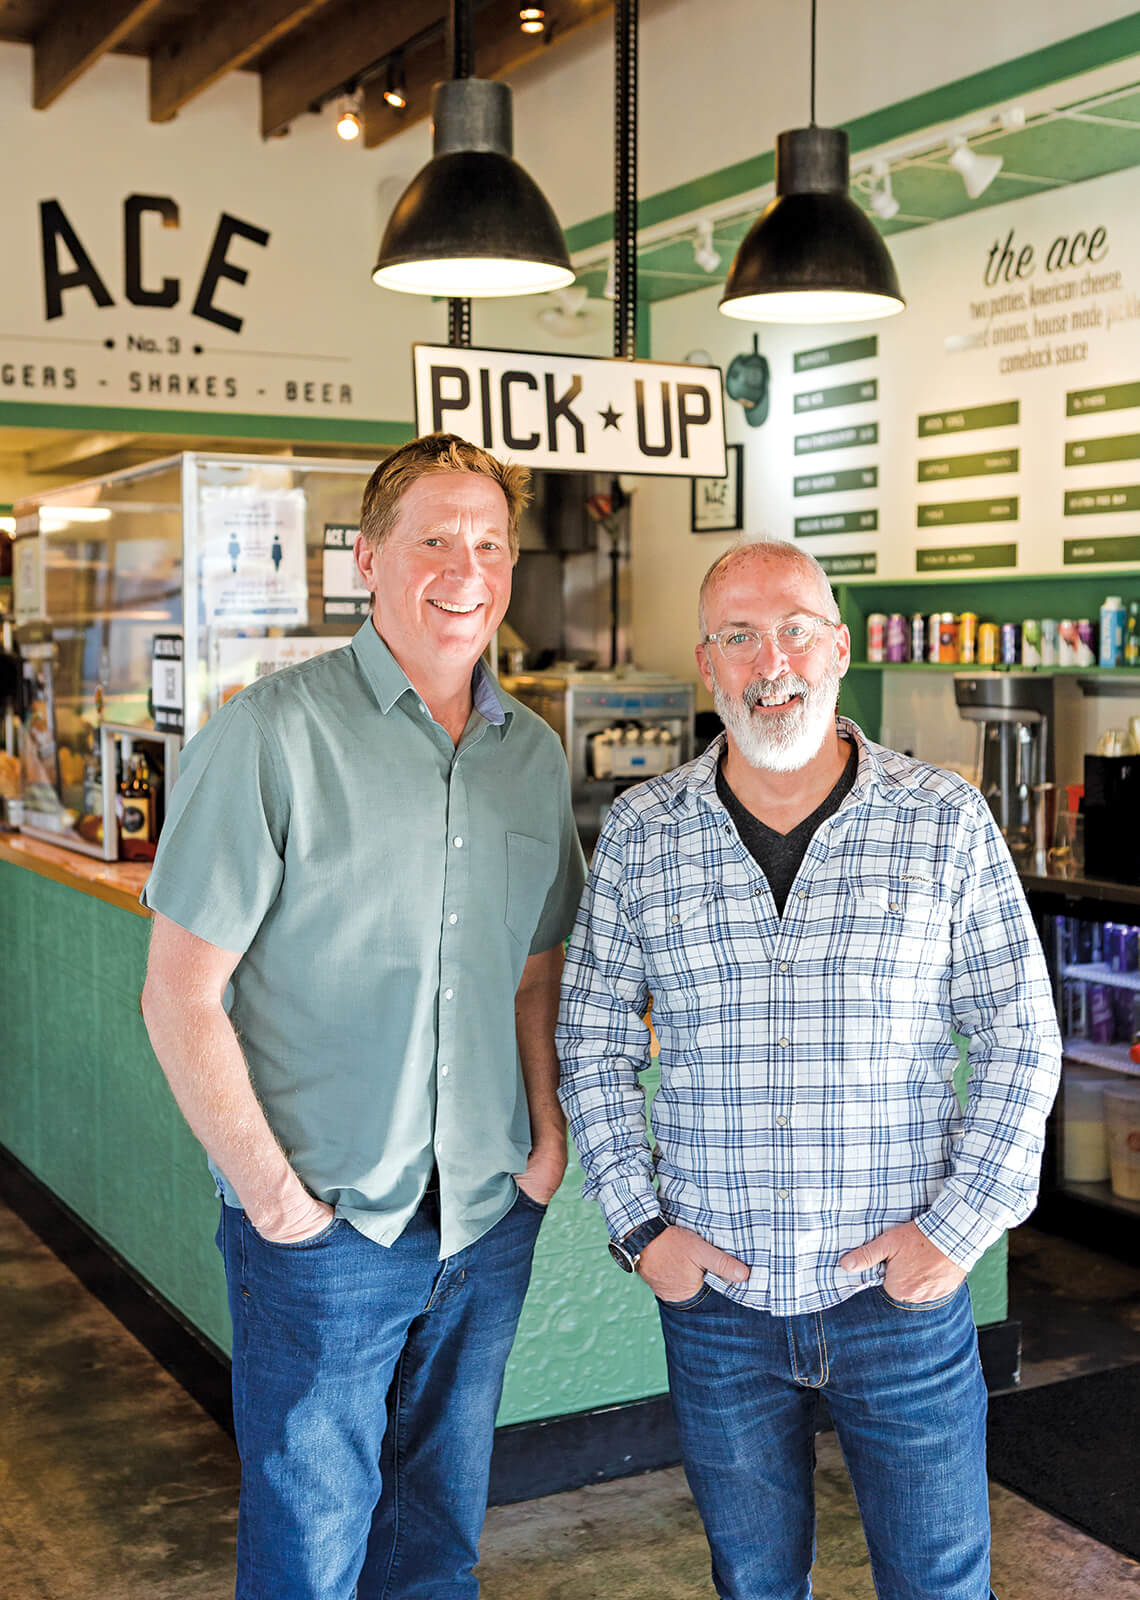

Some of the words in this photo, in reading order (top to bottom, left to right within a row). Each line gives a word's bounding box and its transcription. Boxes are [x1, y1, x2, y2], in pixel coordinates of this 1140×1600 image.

[38, 192, 271, 335] ACE
[983, 227, 1035, 288] the
[1046, 225, 1109, 273] ace
[1033, 312, 1067, 337] house
[1055, 342, 1087, 367] sauce
[129, 371, 239, 397] SHAKES
[286, 380, 353, 404] BEER
[430, 365, 586, 453] PICK
[634, 379, 712, 459] UP
